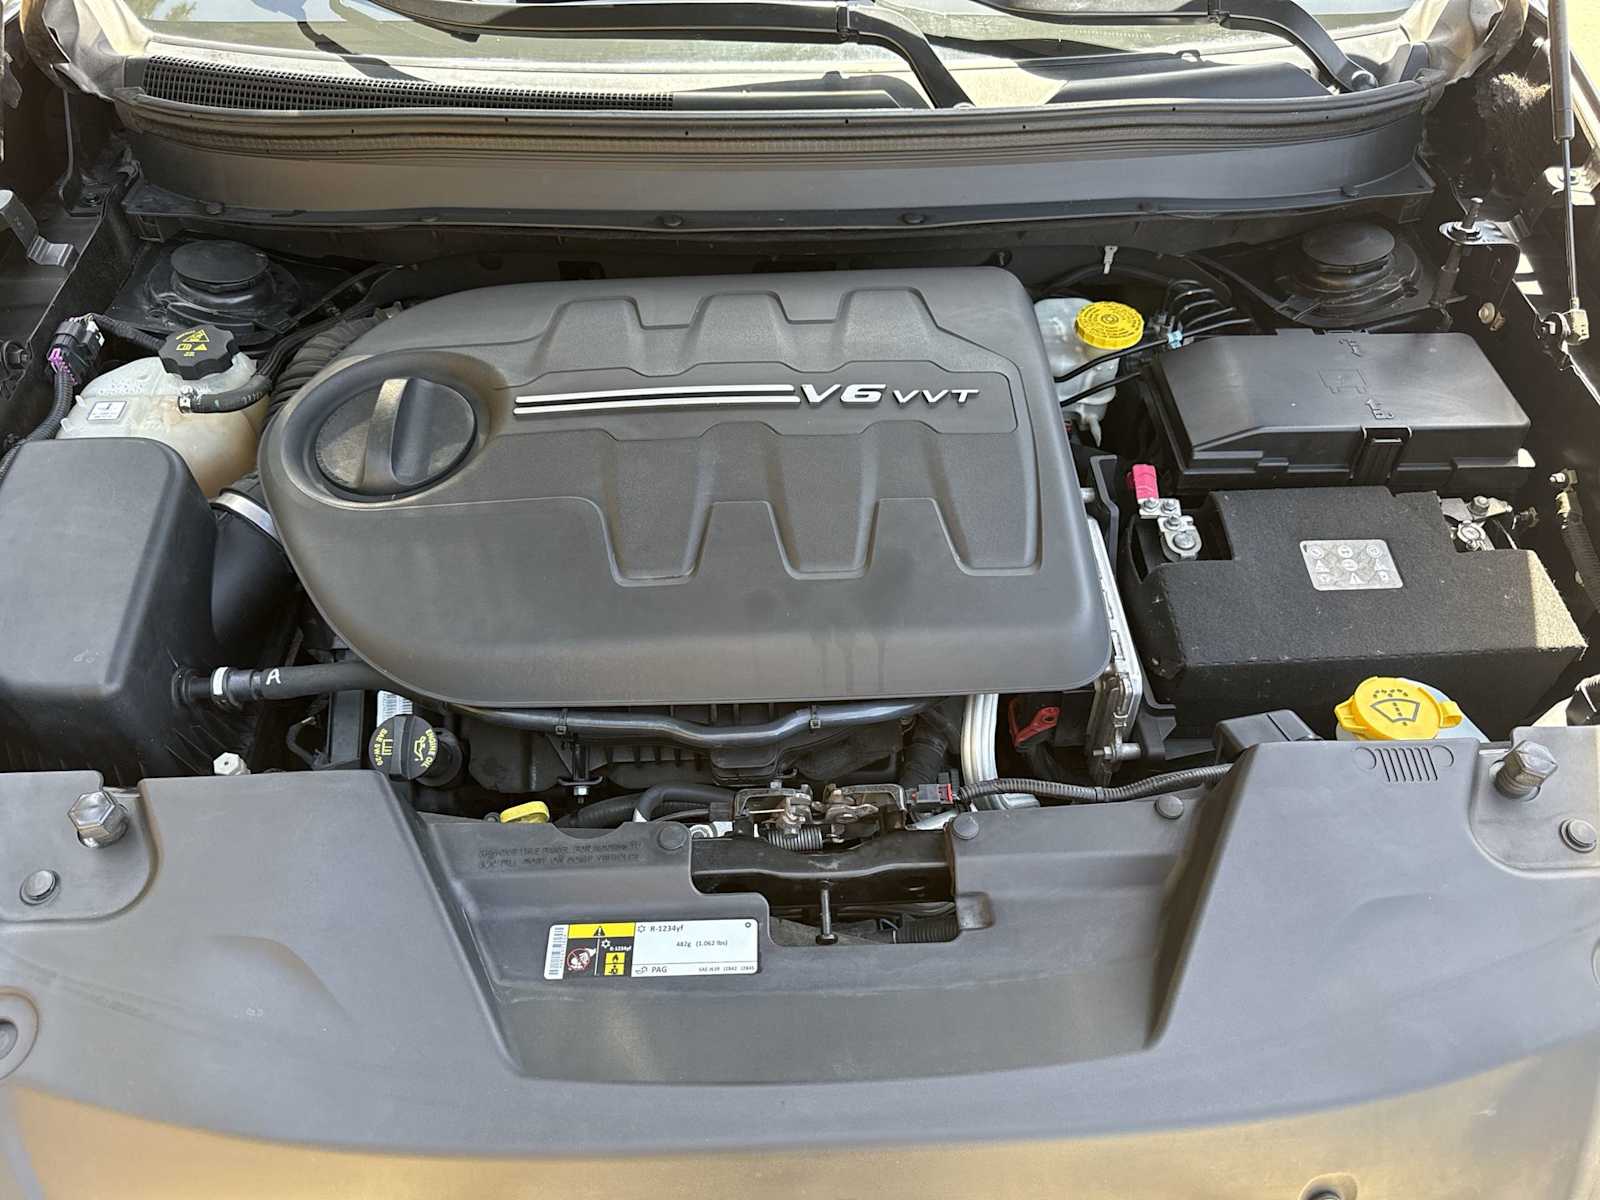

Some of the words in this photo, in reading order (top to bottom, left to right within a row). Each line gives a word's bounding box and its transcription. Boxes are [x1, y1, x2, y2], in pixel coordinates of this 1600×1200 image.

[800, 383, 887, 405] V6
[892, 388, 980, 405] VVT
[266, 667, 281, 685] A
[425, 728, 438, 754] ENGINE
[420, 756, 434, 768] OIL
[650, 924, 684, 933] R-1234yf
[651, 966, 668, 974] PAG
